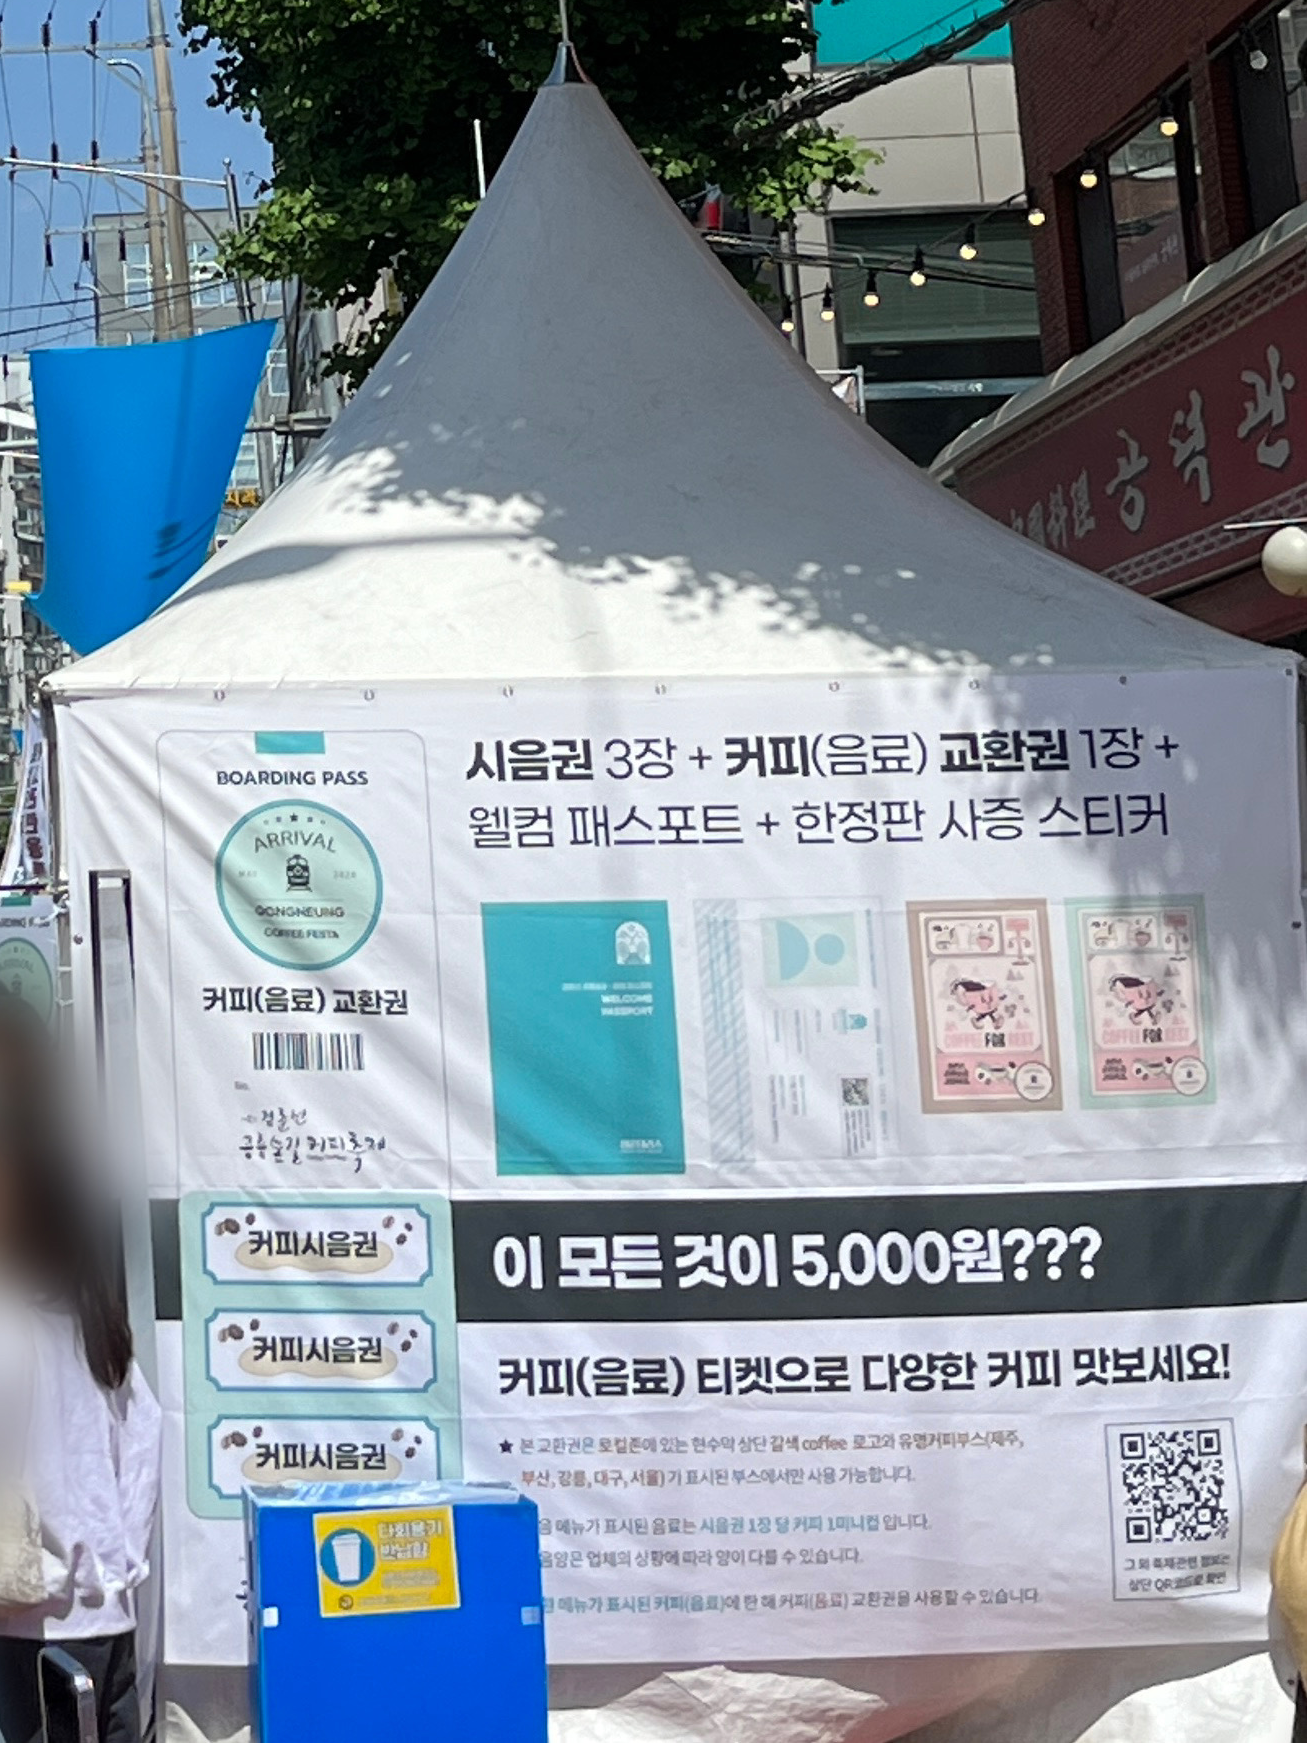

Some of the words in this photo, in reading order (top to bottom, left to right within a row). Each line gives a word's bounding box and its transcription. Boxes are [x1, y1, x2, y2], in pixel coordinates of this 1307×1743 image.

[466, 736, 594, 782] 시음권
[604, 737, 677, 780] 3장
[724, 731, 928, 778] 커피(음료)
[939, 728, 1070, 773] 교환권
[1078, 726, 1144, 770] 1장
[216, 770, 316, 785] BOARDING
[322, 770, 369, 785] PASS
[468, 805, 556, 850] 웰컴
[567, 804, 744, 848] 패스포트
[791, 800, 926, 845] 한정판
[939, 797, 1025, 841] 사증
[1039, 792, 1169, 838] 스티커
[253, 829, 337, 855] ARRIVAL
[202, 985, 326, 1015] 커피(음료)
[332, 988, 409, 1015] 교환권
[248, 1229, 379, 1258] 커피시음권
[492, 1234, 544, 1290] 이
[558, 1234, 664, 1289] 모든
[673, 1232, 780, 1289] 것이
[791, 1225, 1104, 1290] 5,000원???
[253, 1335, 383, 1364] 커피시음권
[498, 1355, 686, 1398] 커피(음료)
[696, 1354, 852, 1396] 티켓으로
[862, 1350, 978, 1394] 다양한
[987, 1348, 1062, 1390] 커피
[1073, 1342, 1231, 1387] 맛보세요!
[256, 1442, 388, 1471] 커피시음권
[520, 1436, 535, 1455] 본
[537, 1436, 594, 1455] 교환권은
[597, 1435, 658, 1454] 로컬존에
[659, 1435, 689, 1455] 있는
[691, 1435, 736, 1454] 현수막
[738, 1435, 768, 1453] 상단
[770, 1434, 799, 1453] 갈색
[801, 1434, 848, 1452] coffee
[853, 1432, 896, 1451] 로고와
[685, 1467, 729, 1487] 표시된
[732, 1466, 805, 1486] 부스에서만
[807, 1465, 836, 1485] 사용
[839, 1464, 916, 1485] 가능합니다.
[555, 1517, 601, 1536] 메뉴가
[603, 1517, 649, 1536] 표시된
[652, 1517, 697, 1535] 음료는
[699, 1515, 744, 1535] 시음권
[793, 1514, 823, 1533] 커피
[586, 1549, 632, 1568] 업체의
[635, 1549, 681, 1568] 상황에
[682, 1549, 713, 1567] 따라
[715, 1549, 745, 1567] 양이
[748, 1548, 778, 1567] 다를
[782, 1549, 797, 1566] 수
[799, 1547, 864, 1566] 있습니다.
[557, 1595, 603, 1615] 메뉴가
[606, 1595, 651, 1614] 표시된
[851, 1590, 911, 1608] 교환권을
[914, 1589, 959, 1607] 사용할
[961, 1589, 976, 1606] 수
